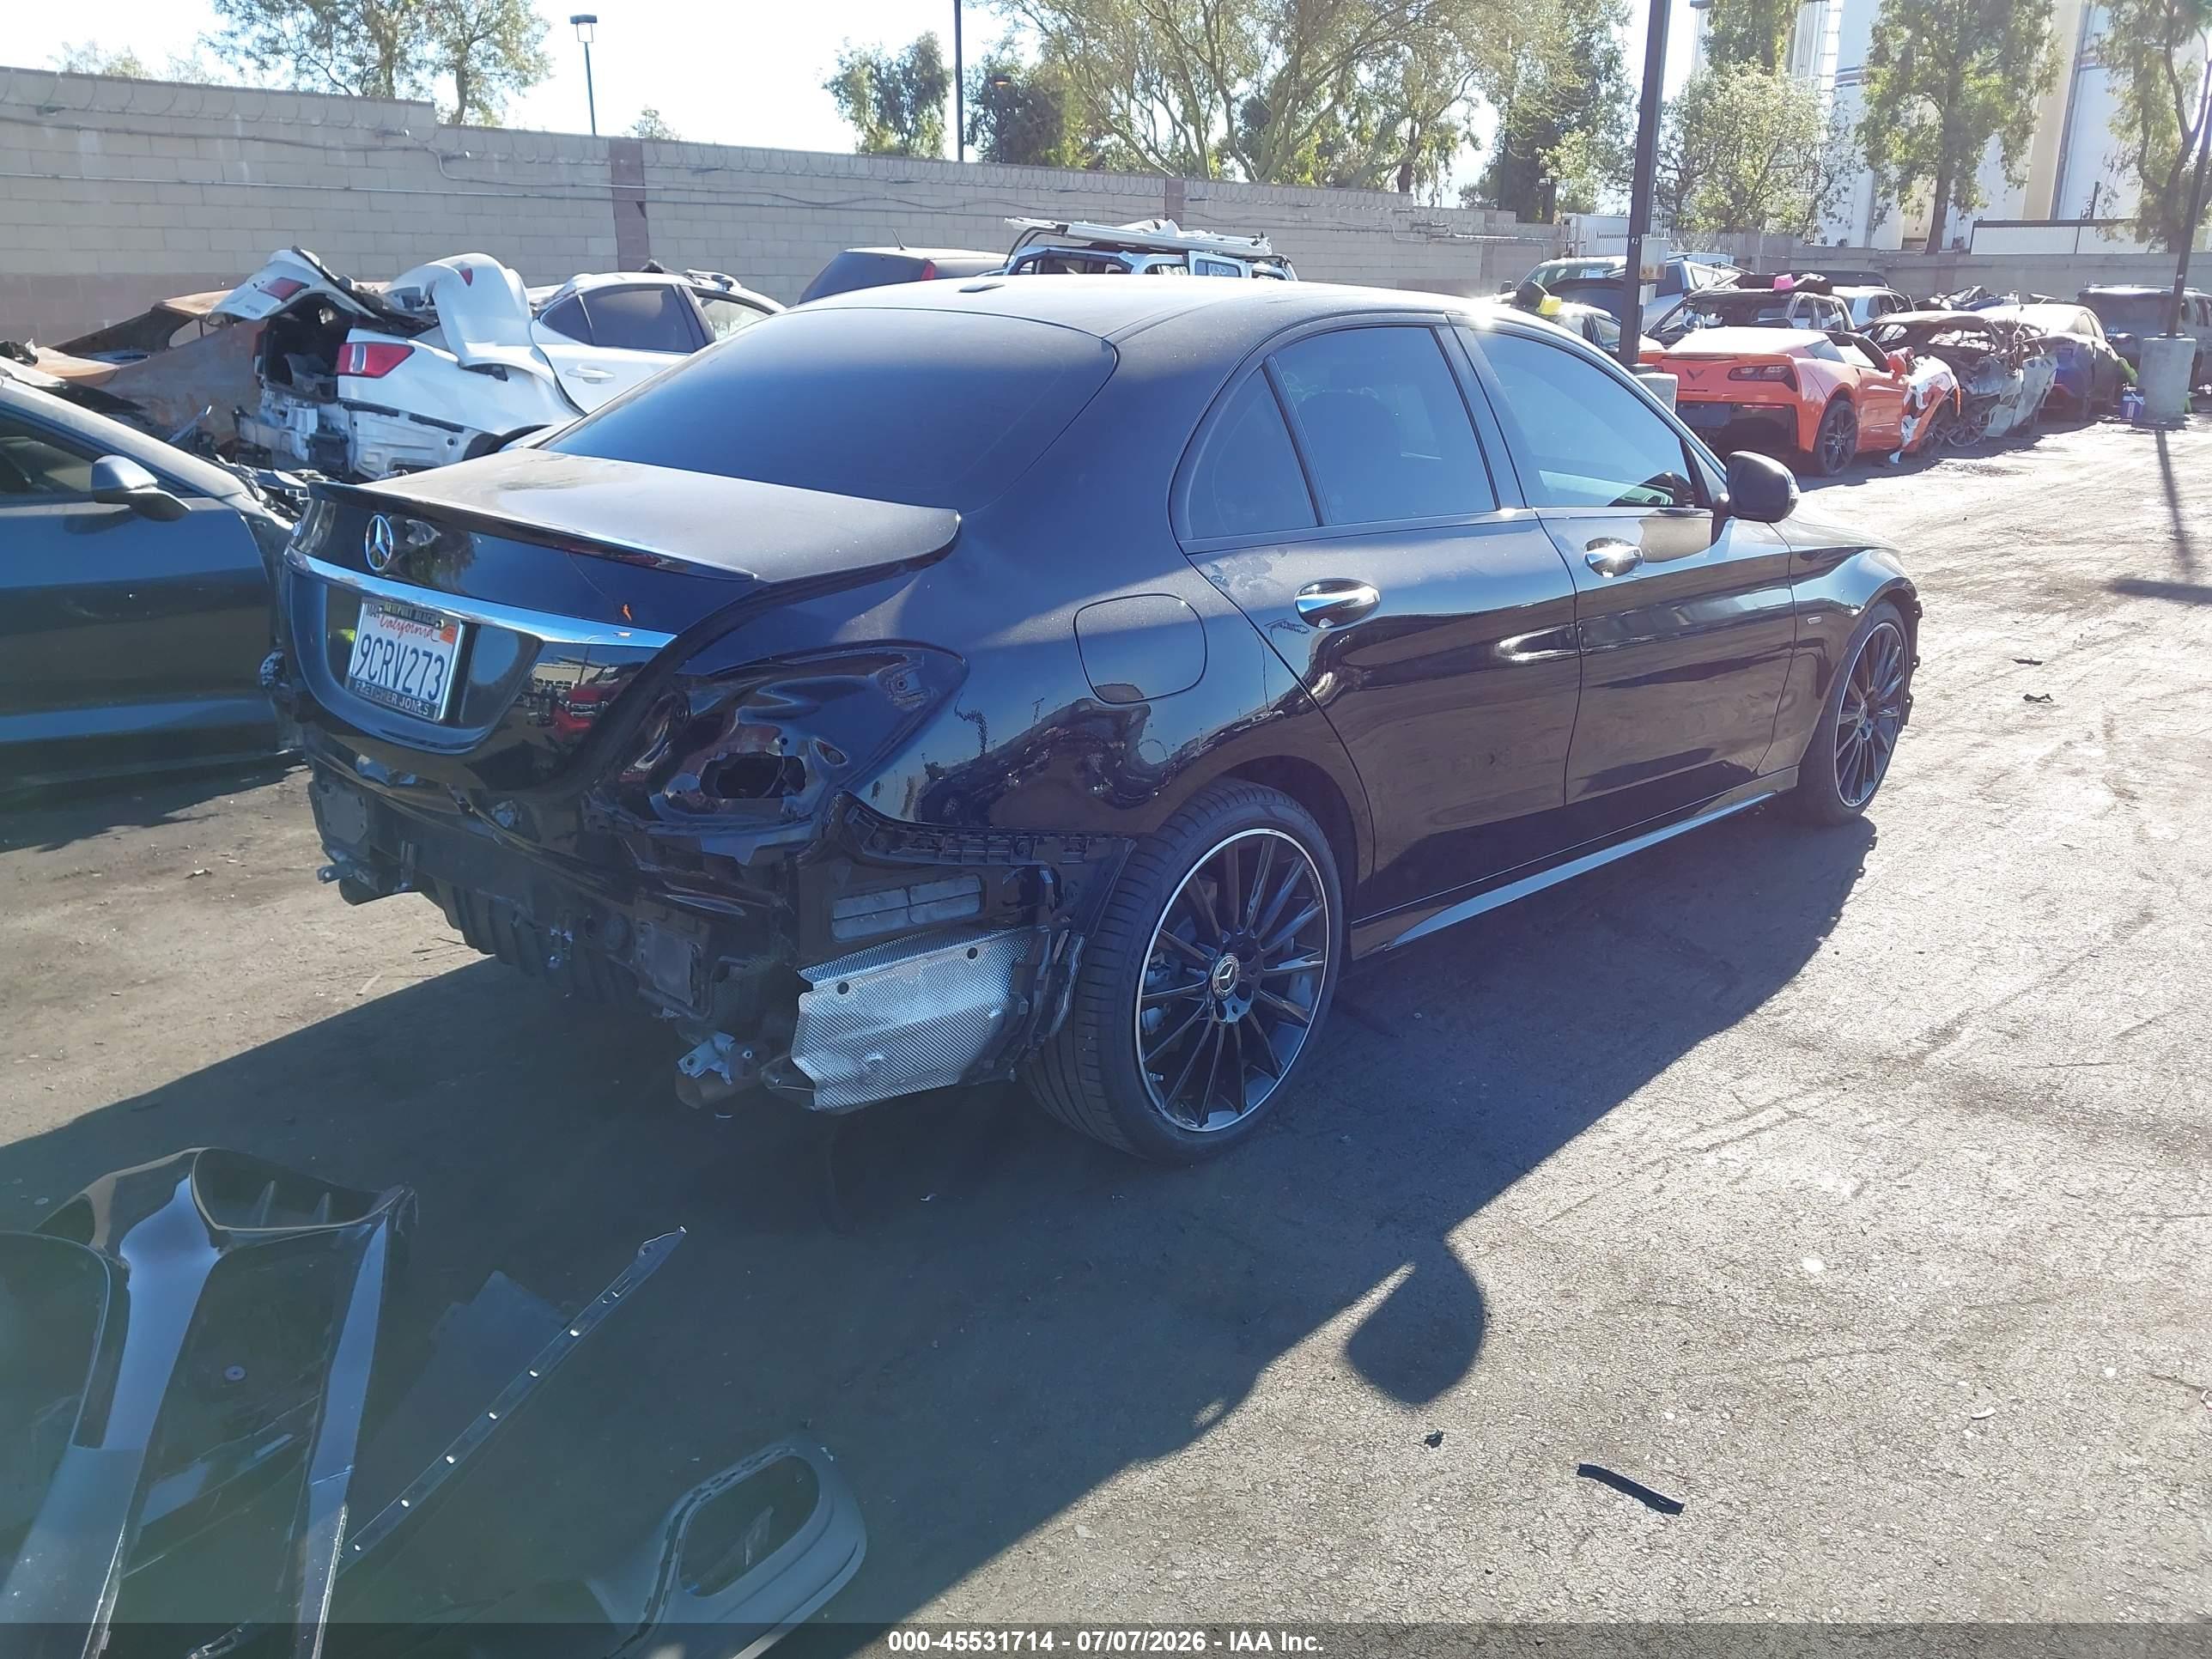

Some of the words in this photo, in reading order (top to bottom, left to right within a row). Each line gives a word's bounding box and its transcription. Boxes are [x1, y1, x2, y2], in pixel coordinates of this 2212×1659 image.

[380, 616, 440, 642] California
[355, 633, 446, 702] 9CRV273
[356, 681, 398, 706] FLETCHER
[399, 696, 430, 716] JONES
